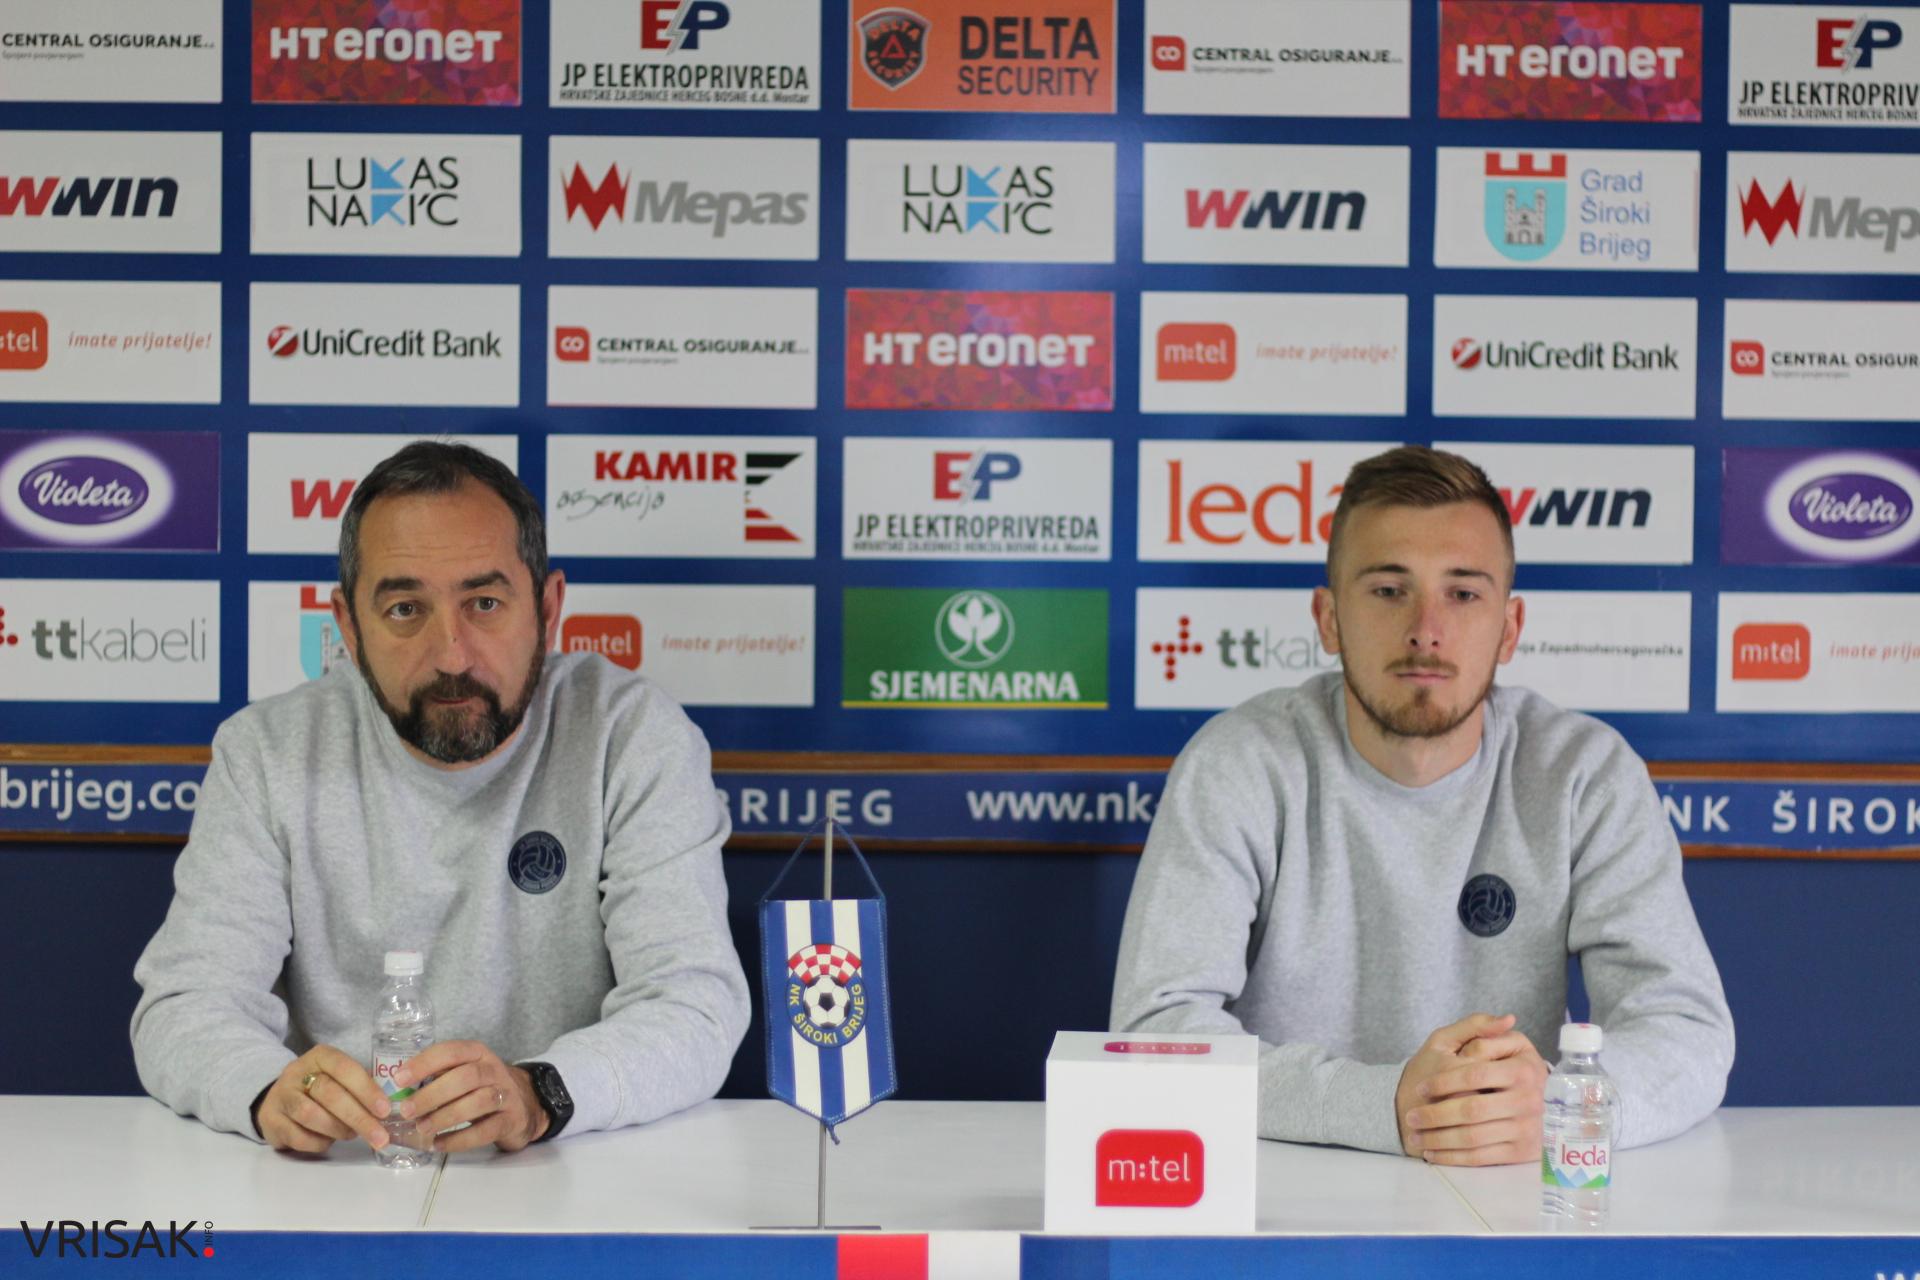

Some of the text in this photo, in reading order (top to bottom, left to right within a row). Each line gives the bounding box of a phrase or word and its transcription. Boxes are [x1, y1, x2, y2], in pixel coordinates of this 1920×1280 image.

[1, 33, 84, 47] CENTRAL
[270, 27, 329, 60] HT
[959, 15, 1100, 61] DELTA
[1192, 47, 1274, 62] CENTRAL
[1458, 45, 1513, 76] HT
[561, 63, 809, 90] JP ELEKTROPRIVREDA
[957, 64, 1099, 96] SECURITY
[1740, 81, 1919, 107] JP ELEKTROPRIV
[1580, 168, 1643, 193] Grad
[633, 180, 809, 238] Mepas
[1580, 195, 1651, 225] Široki
[1808, 197, 1920, 253] Mep
[1579, 231, 1652, 262] Brijeg
[68, 331, 212, 353] imate prijatelje!
[303, 329, 501, 358] UniCredit Bank
[596, 337, 678, 353] CENTRAL
[864, 332, 923, 365] HT
[1163, 339, 1227, 364] m:tel
[1485, 341, 1678, 370] UniCredit Bank
[1771, 352, 1919, 368] CENTRAL OSIGUR
[595, 451, 737, 482] KAMIR
[33, 471, 133, 507] Violeta
[1802, 487, 1899, 523] Violeta
[855, 514, 1099, 540] JP ELEKTROPRIVREDA
[31, 618, 206, 660] ttkabeli
[1830, 643, 1920, 663] imate prija
[869, 670, 1079, 700] SJEMENARNA
[0, 767, 201, 821] brijeg.co
[966, 781, 1160, 822] www.nk
[1663, 795, 1731, 832] NK
[789, 983, 800, 1006] NK
[842, 984, 864, 1038] BRIJEG
[1108, 1152, 1191, 1182] m:tel
[1561, 1143, 1607, 1166] leda
